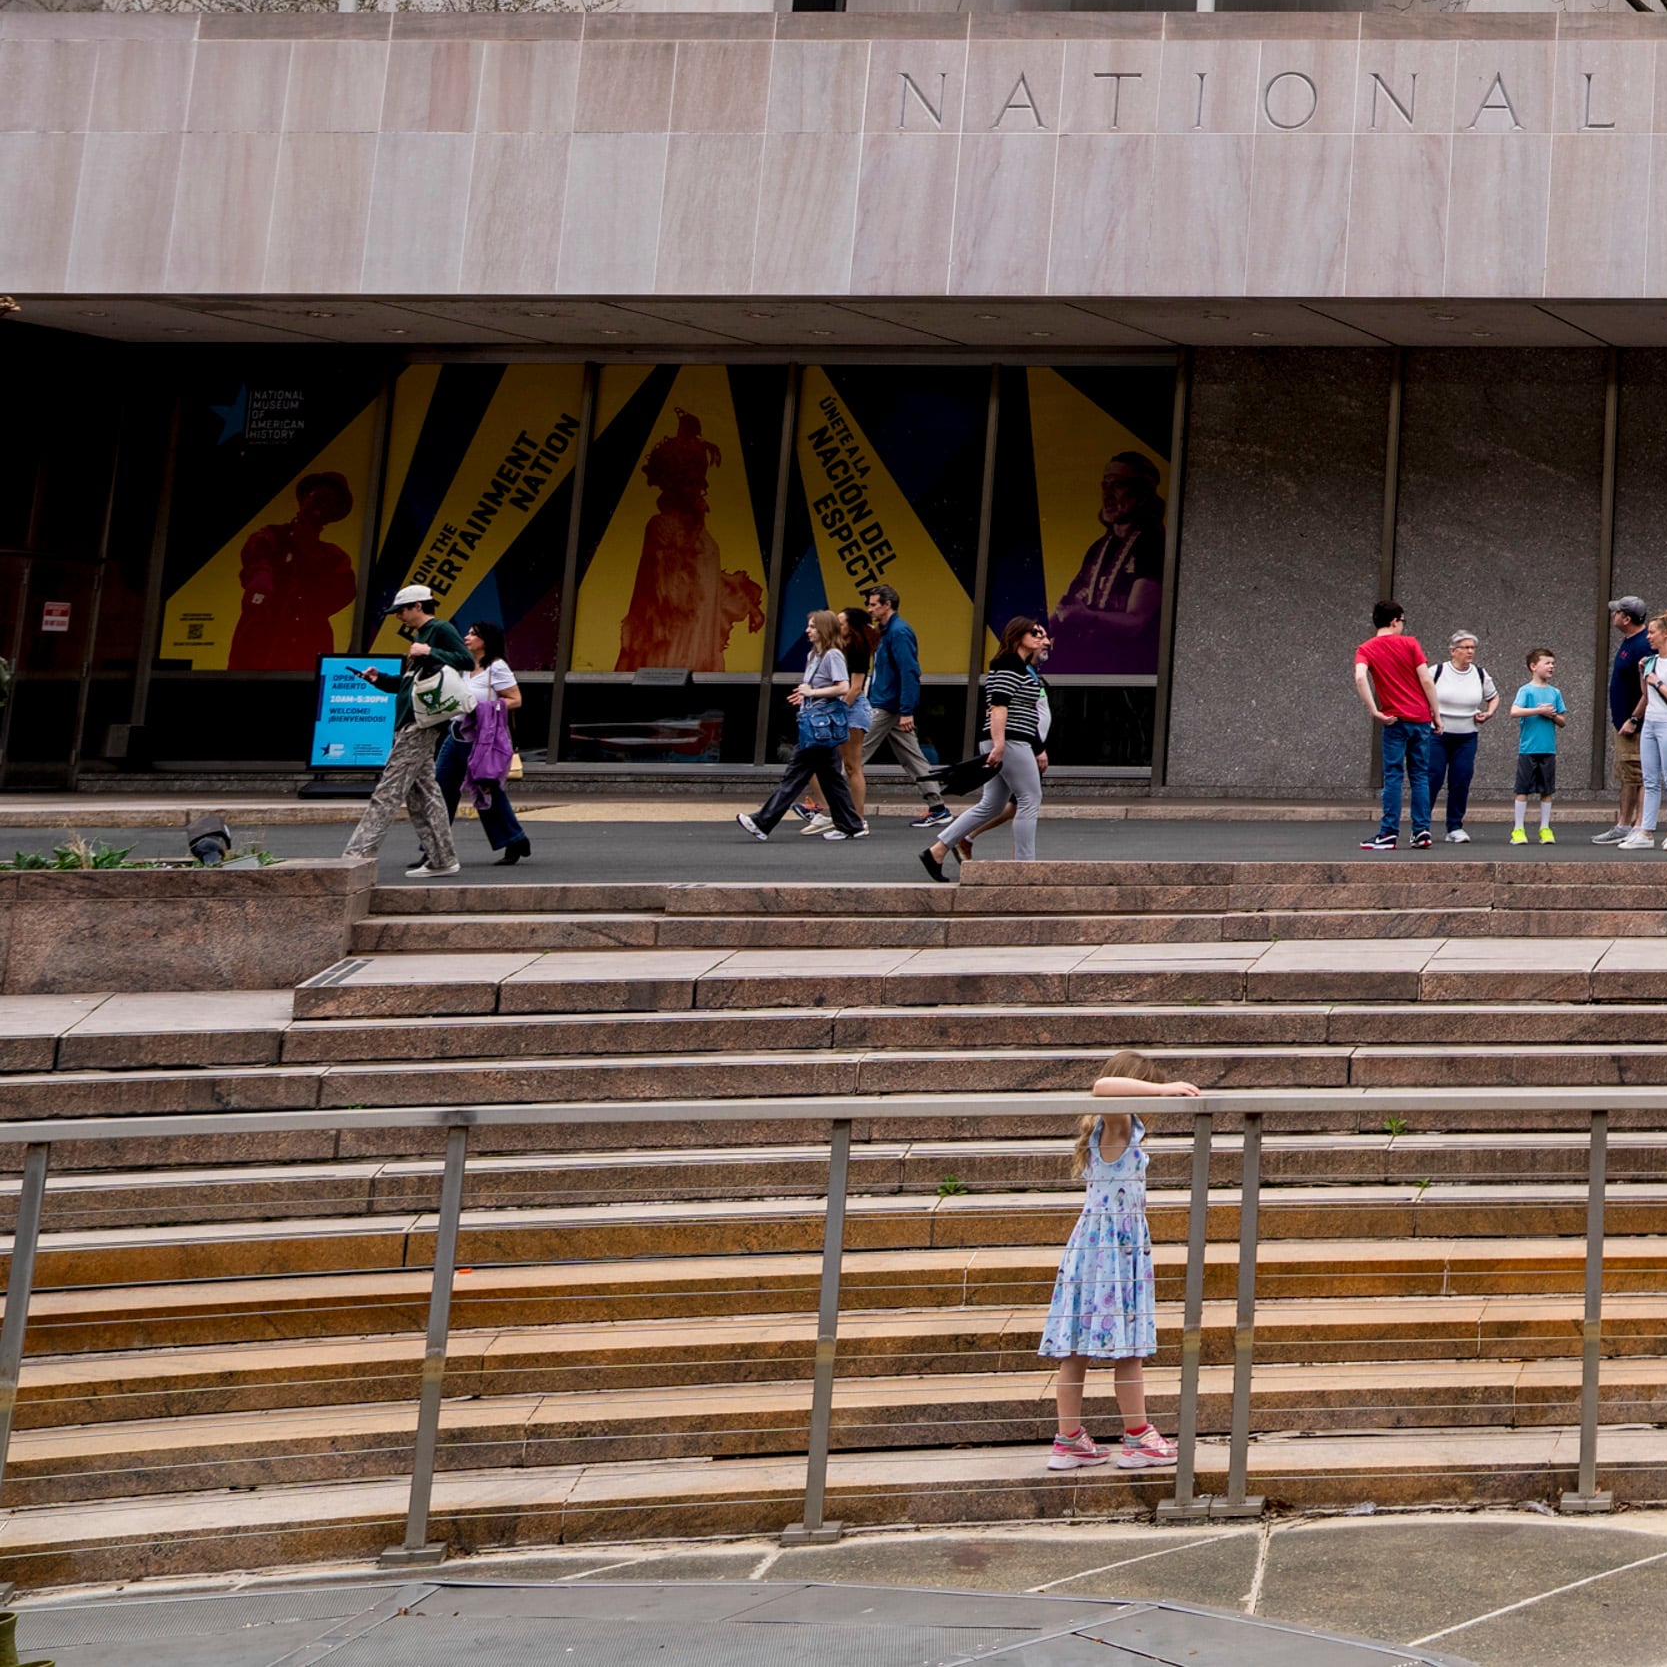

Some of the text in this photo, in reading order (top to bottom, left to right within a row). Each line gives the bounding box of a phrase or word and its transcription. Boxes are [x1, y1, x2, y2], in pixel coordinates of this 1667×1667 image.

[897, 71, 1616, 130] NATIONAL
[253, 390, 304, 400] NATIONAL
[253, 400, 299, 410] MUSEUM
[251, 410, 265, 419] OF
[250, 420, 305, 429] AMERICAN
[249, 429, 295, 439] HISTORY
[819, 396, 872, 479] ÚNETE A LA
[509, 412, 581, 513] NATION
[808, 425, 897, 575] NACIÓN DEL
[430, 522, 458, 555] THE
[333, 674, 355, 682] OPEN
